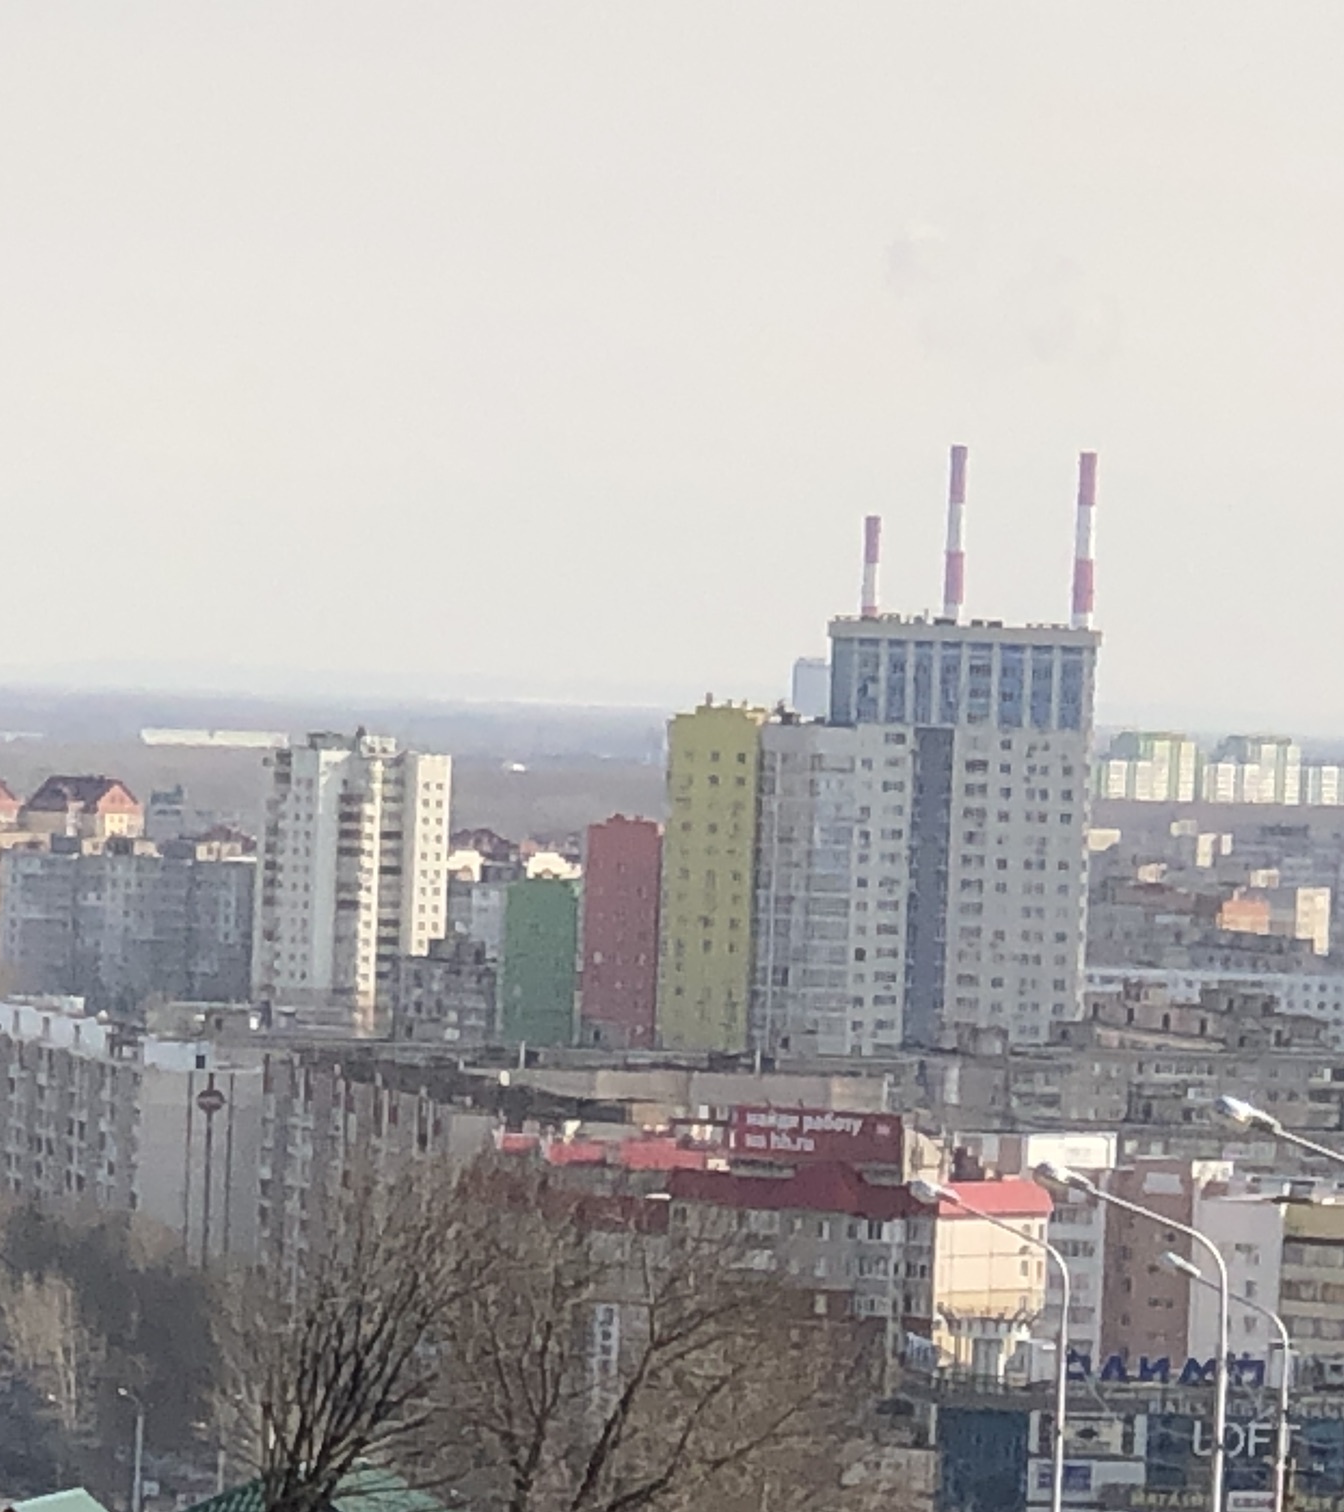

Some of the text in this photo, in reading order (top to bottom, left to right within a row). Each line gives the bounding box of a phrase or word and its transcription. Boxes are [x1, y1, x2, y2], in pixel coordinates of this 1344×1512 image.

[803, 1112, 864, 1137] работу
[745, 1131, 815, 1151] на hh.ru
